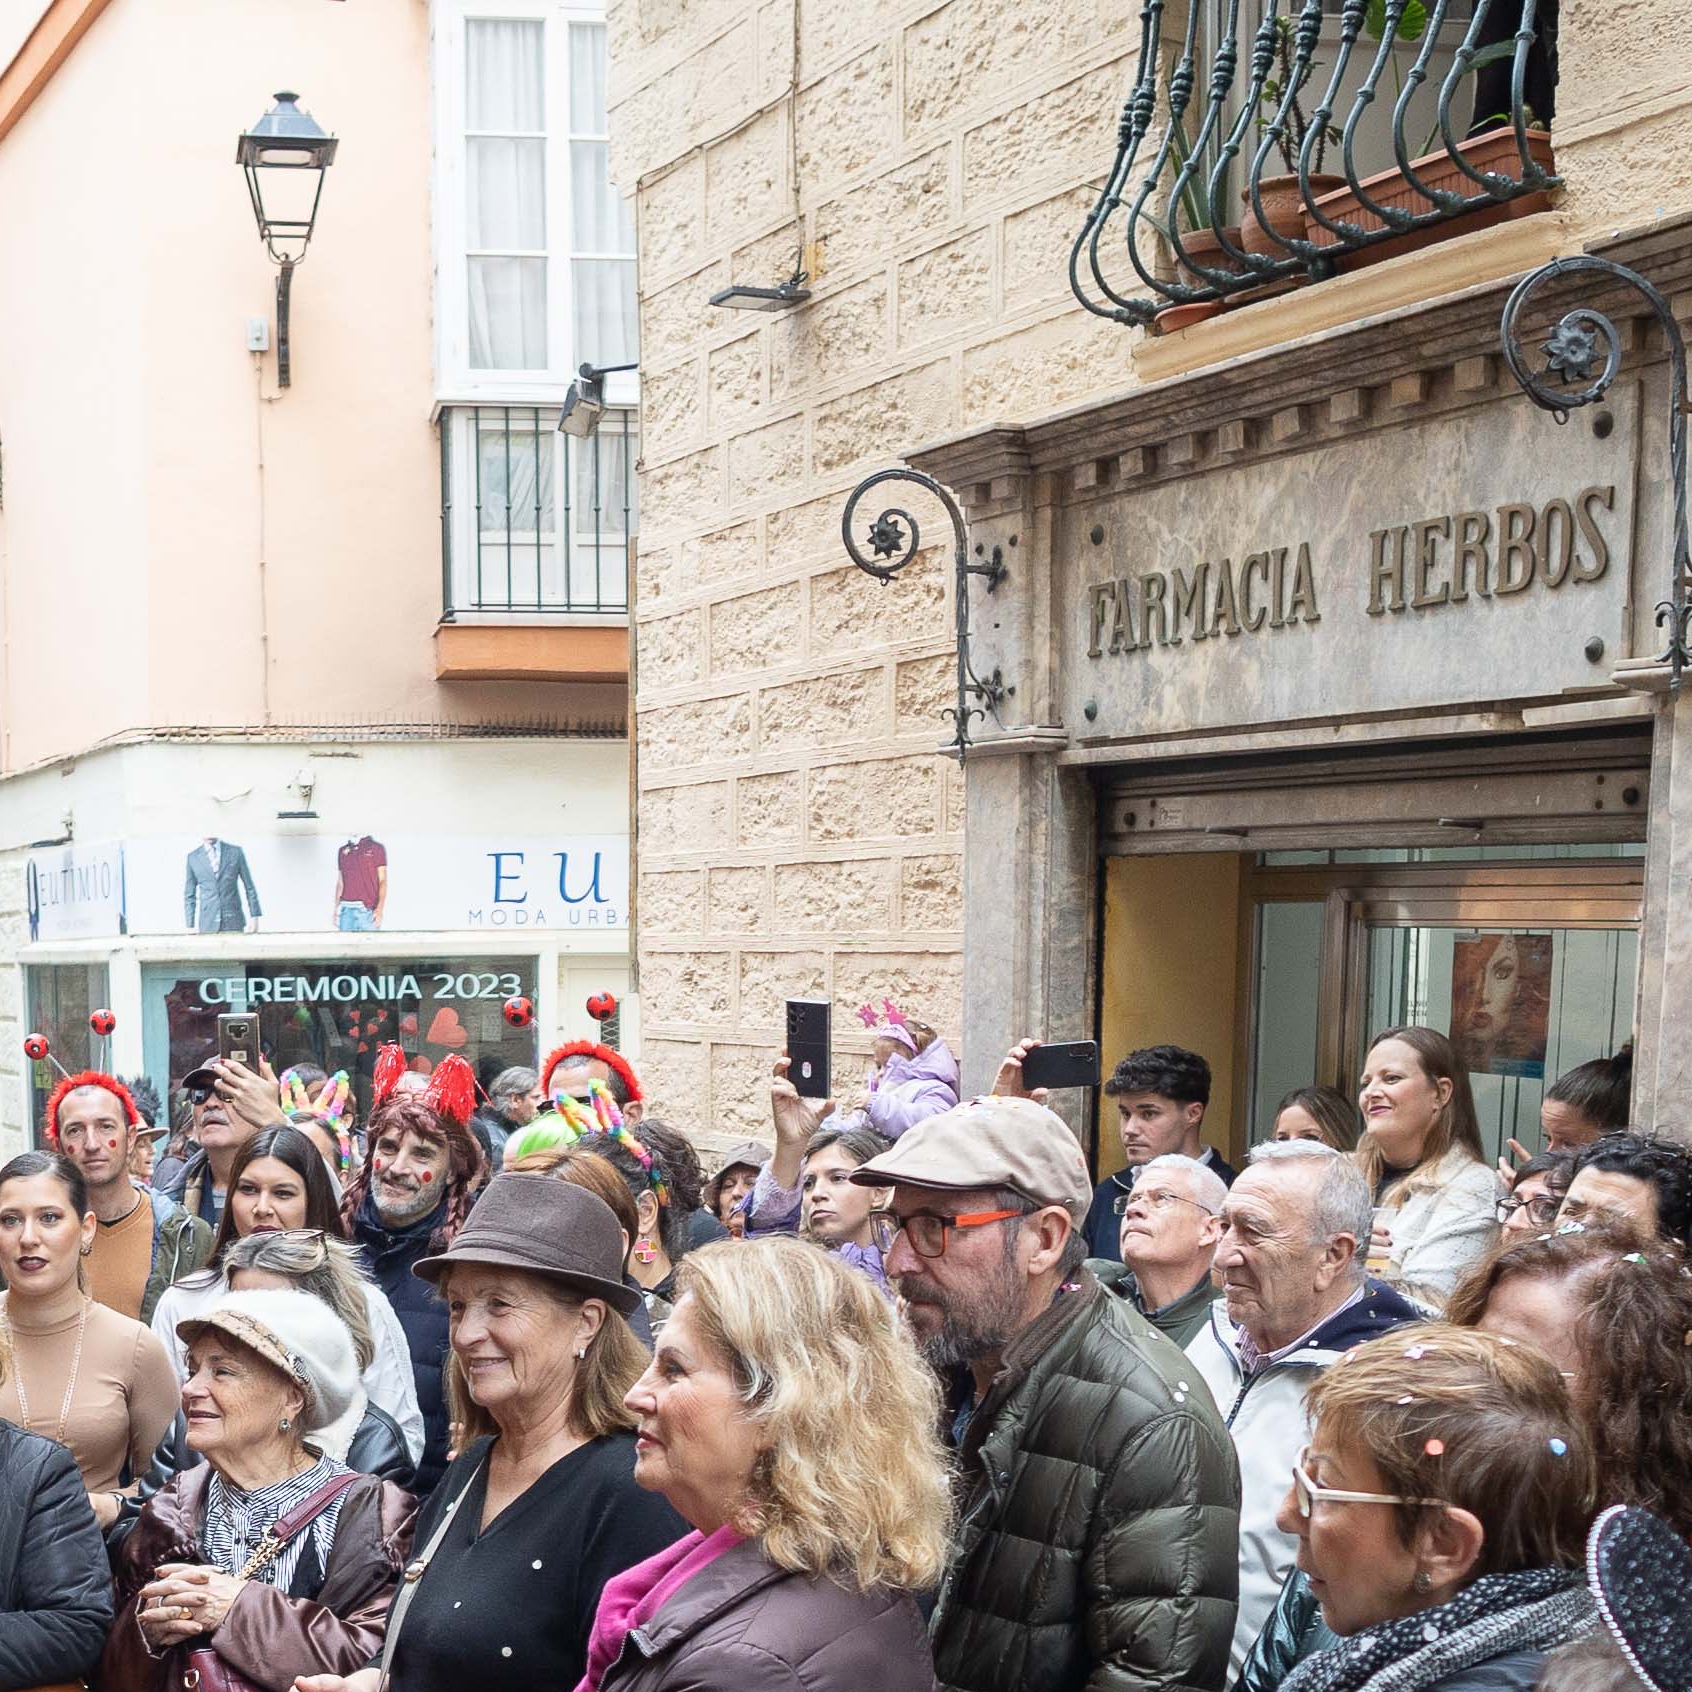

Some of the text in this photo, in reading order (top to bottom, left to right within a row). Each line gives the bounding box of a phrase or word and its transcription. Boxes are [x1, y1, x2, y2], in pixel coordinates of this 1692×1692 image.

[1087, 486, 1615, 657] FARMACIA HERBOS
[469, 909, 629, 925] MODA URB
[199, 973, 522, 1003] CEREMONIA 2023
